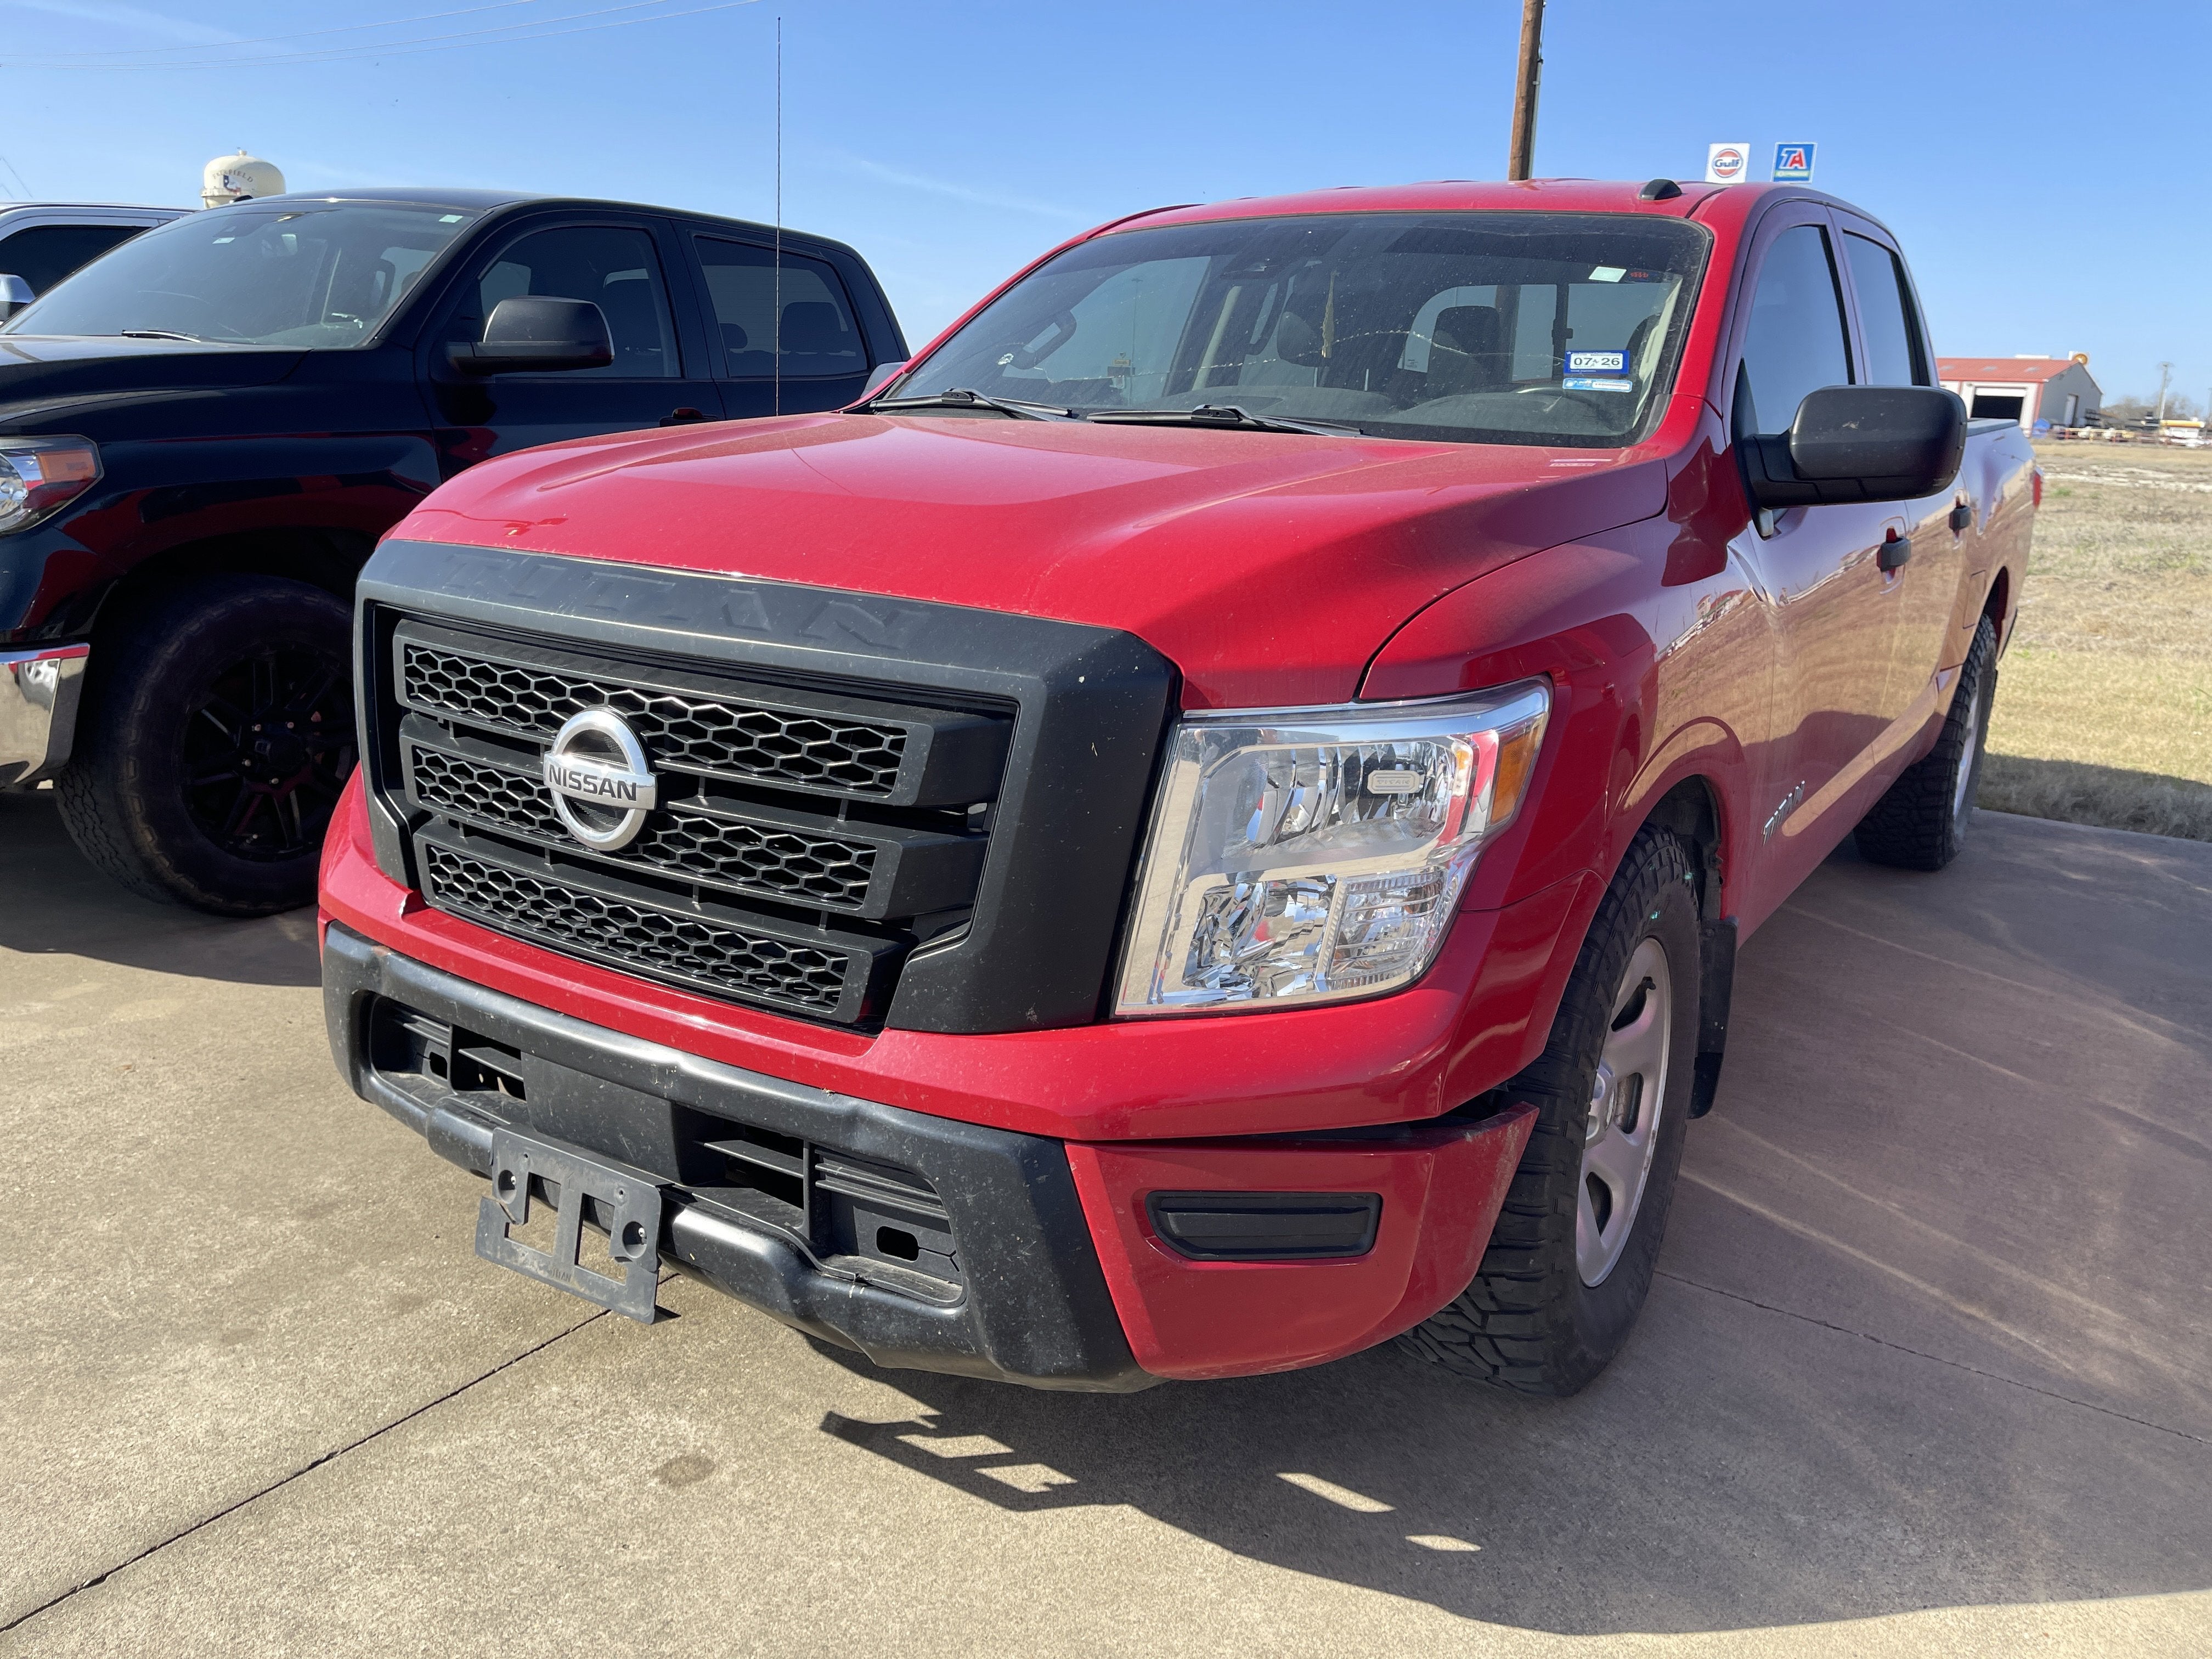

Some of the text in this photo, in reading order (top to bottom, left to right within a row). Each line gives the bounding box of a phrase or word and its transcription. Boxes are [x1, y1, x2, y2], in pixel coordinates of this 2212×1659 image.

[1714, 159, 1740, 167] Gulf
[1780, 148, 1807, 169] TA
[1574, 357, 1620, 365] 07 26
[549, 765, 637, 802] NISSAN
